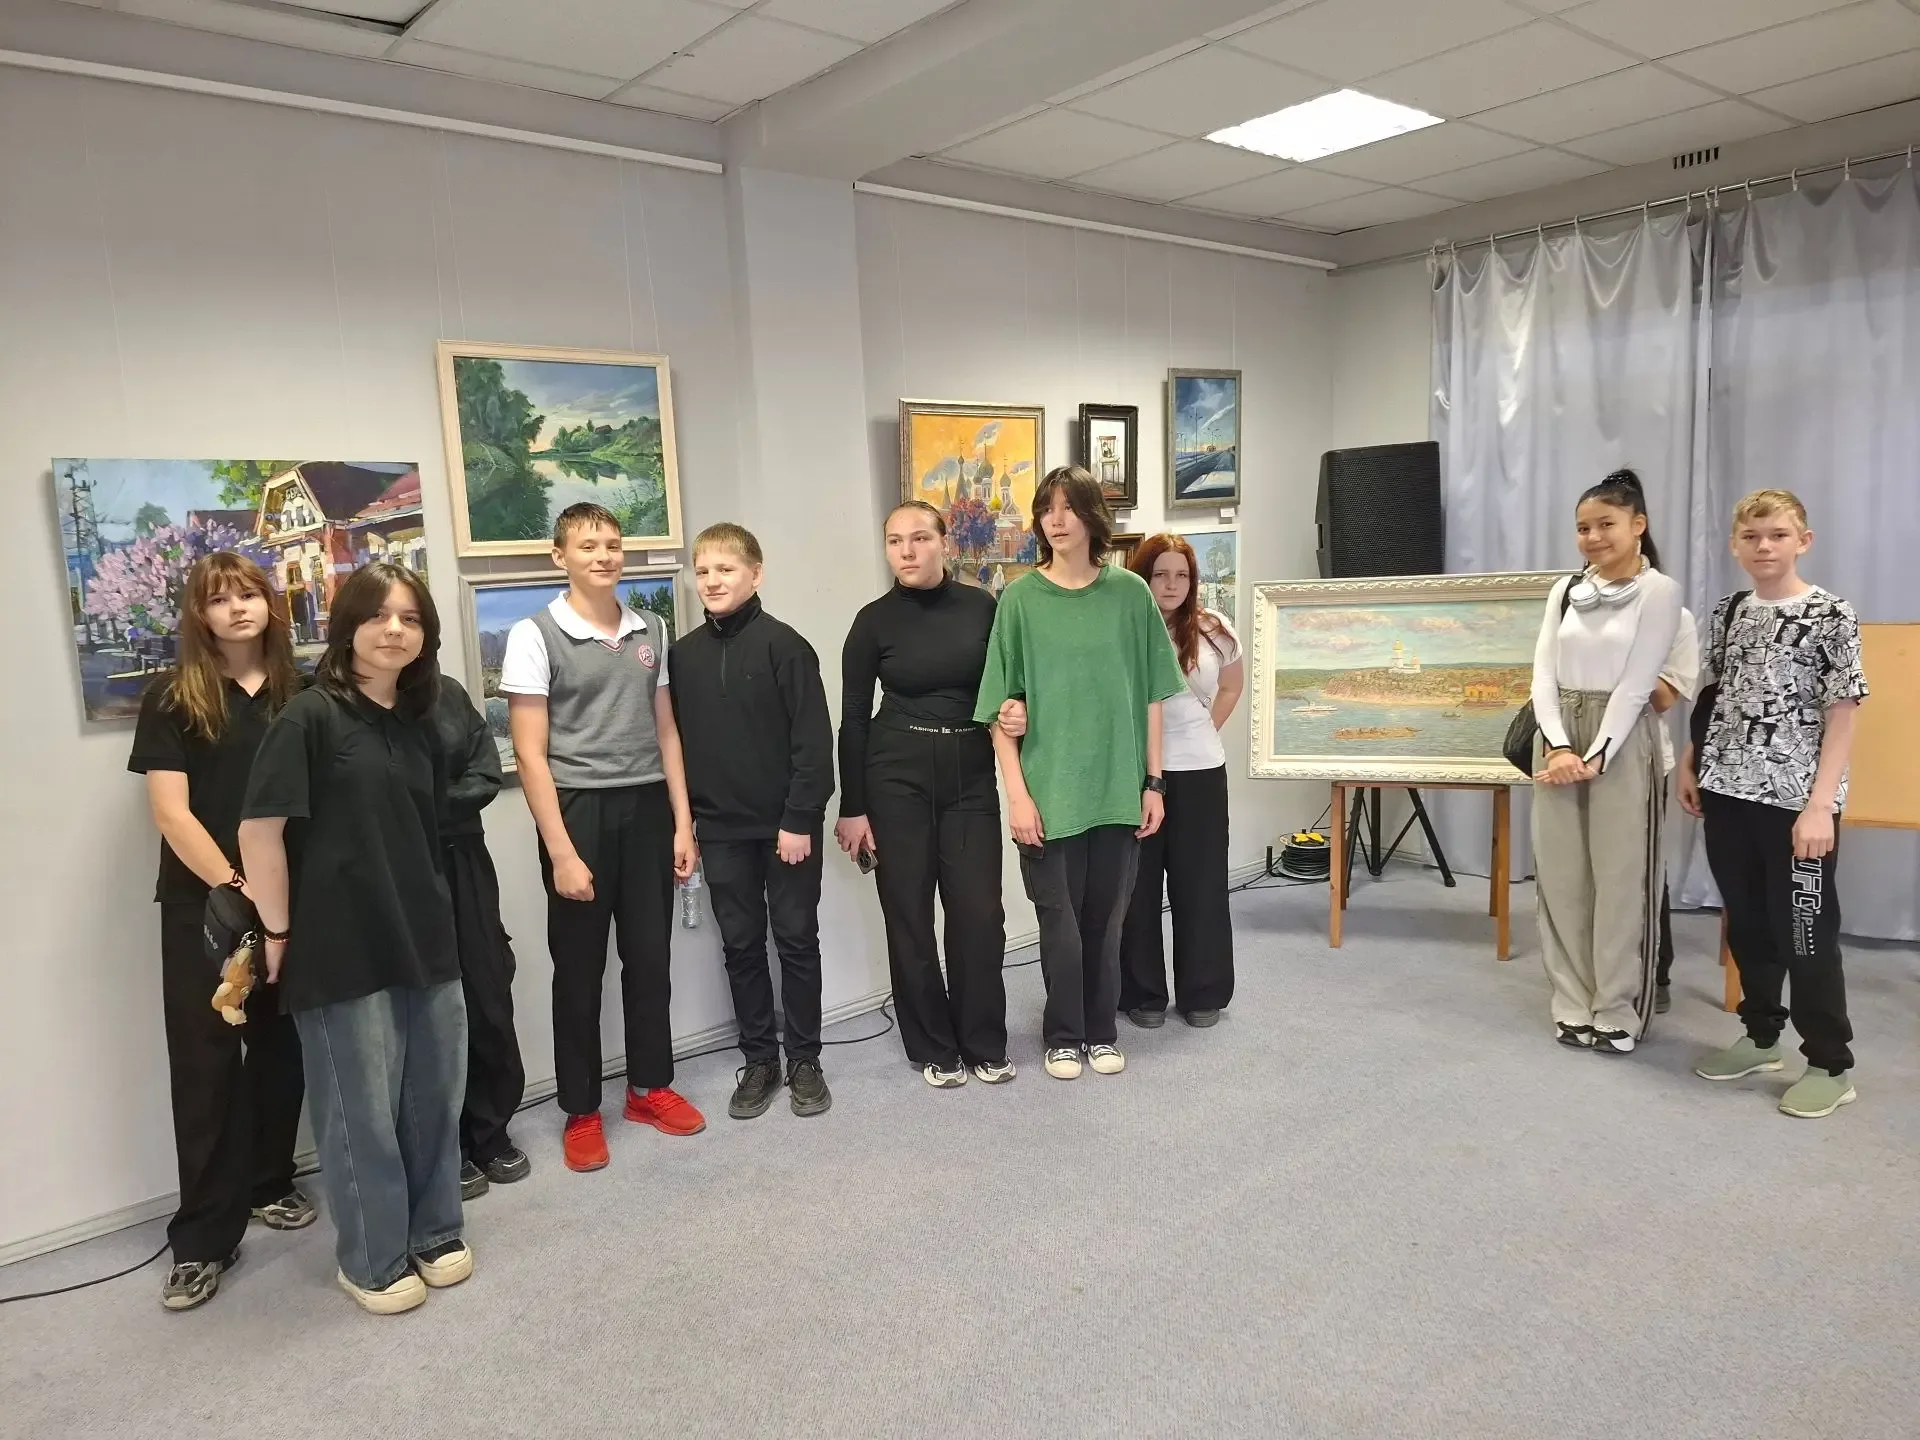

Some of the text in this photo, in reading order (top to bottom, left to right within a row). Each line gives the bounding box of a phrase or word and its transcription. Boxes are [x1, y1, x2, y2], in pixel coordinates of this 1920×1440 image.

[909, 725, 939, 733] FASHION
[1791, 855, 1822, 910] UFC
[1792, 907, 1804, 956] EXPERIENCE
[1800, 902, 1814, 926] VIP
